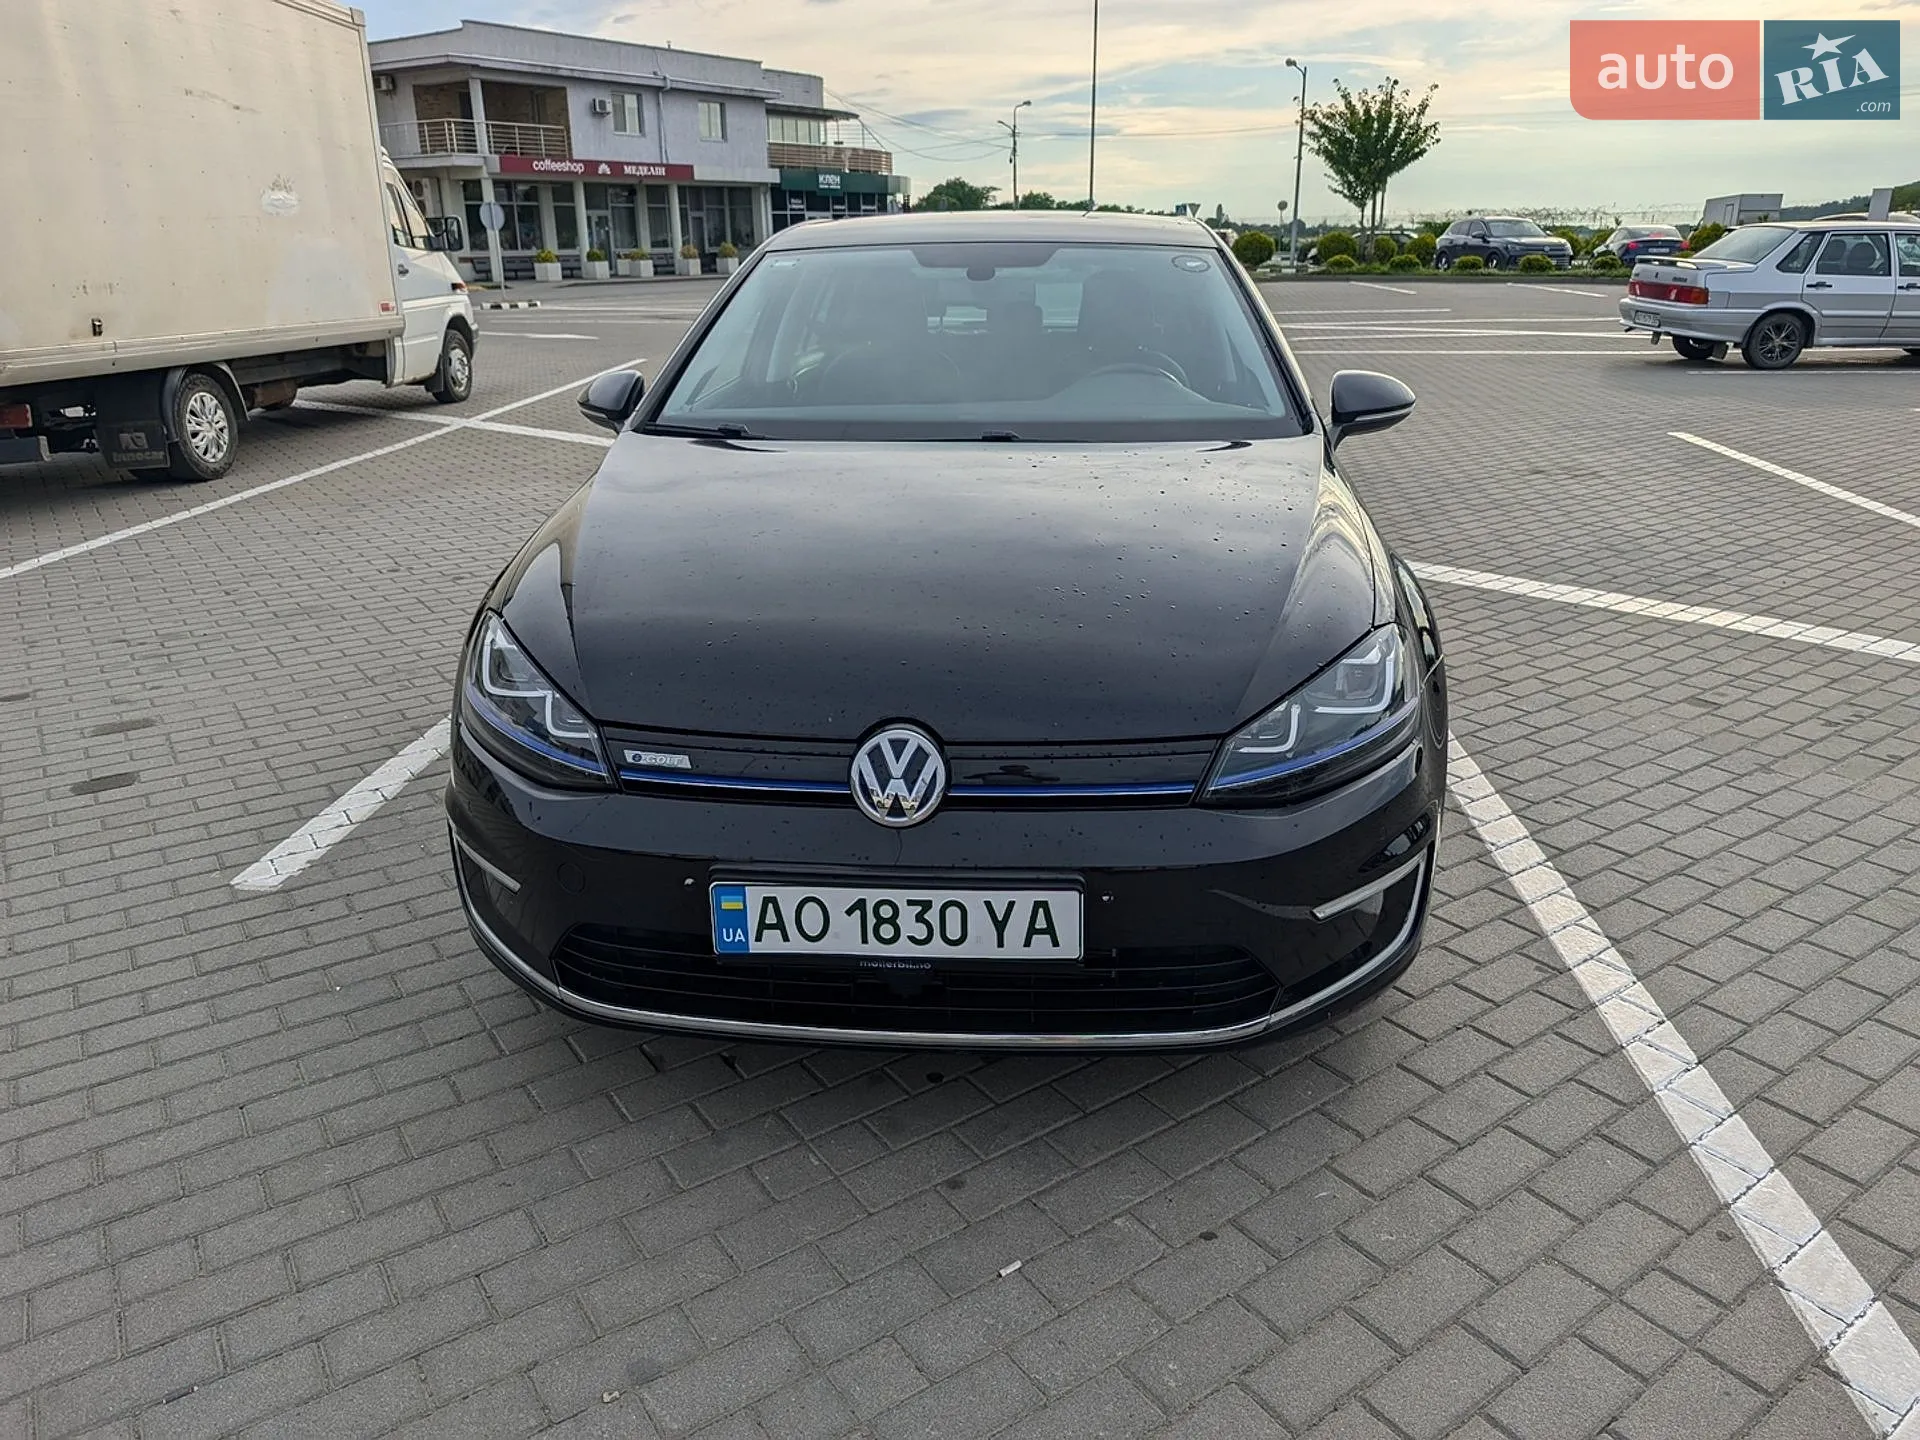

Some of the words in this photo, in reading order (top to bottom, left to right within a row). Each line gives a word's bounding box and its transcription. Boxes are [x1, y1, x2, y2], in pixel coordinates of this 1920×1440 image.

[532, 159, 585, 175] coffeeshop
[722, 927, 747, 944] UA
[754, 895, 831, 944] AO
[843, 897, 969, 948] 1830
[982, 899, 1061, 949] YA
